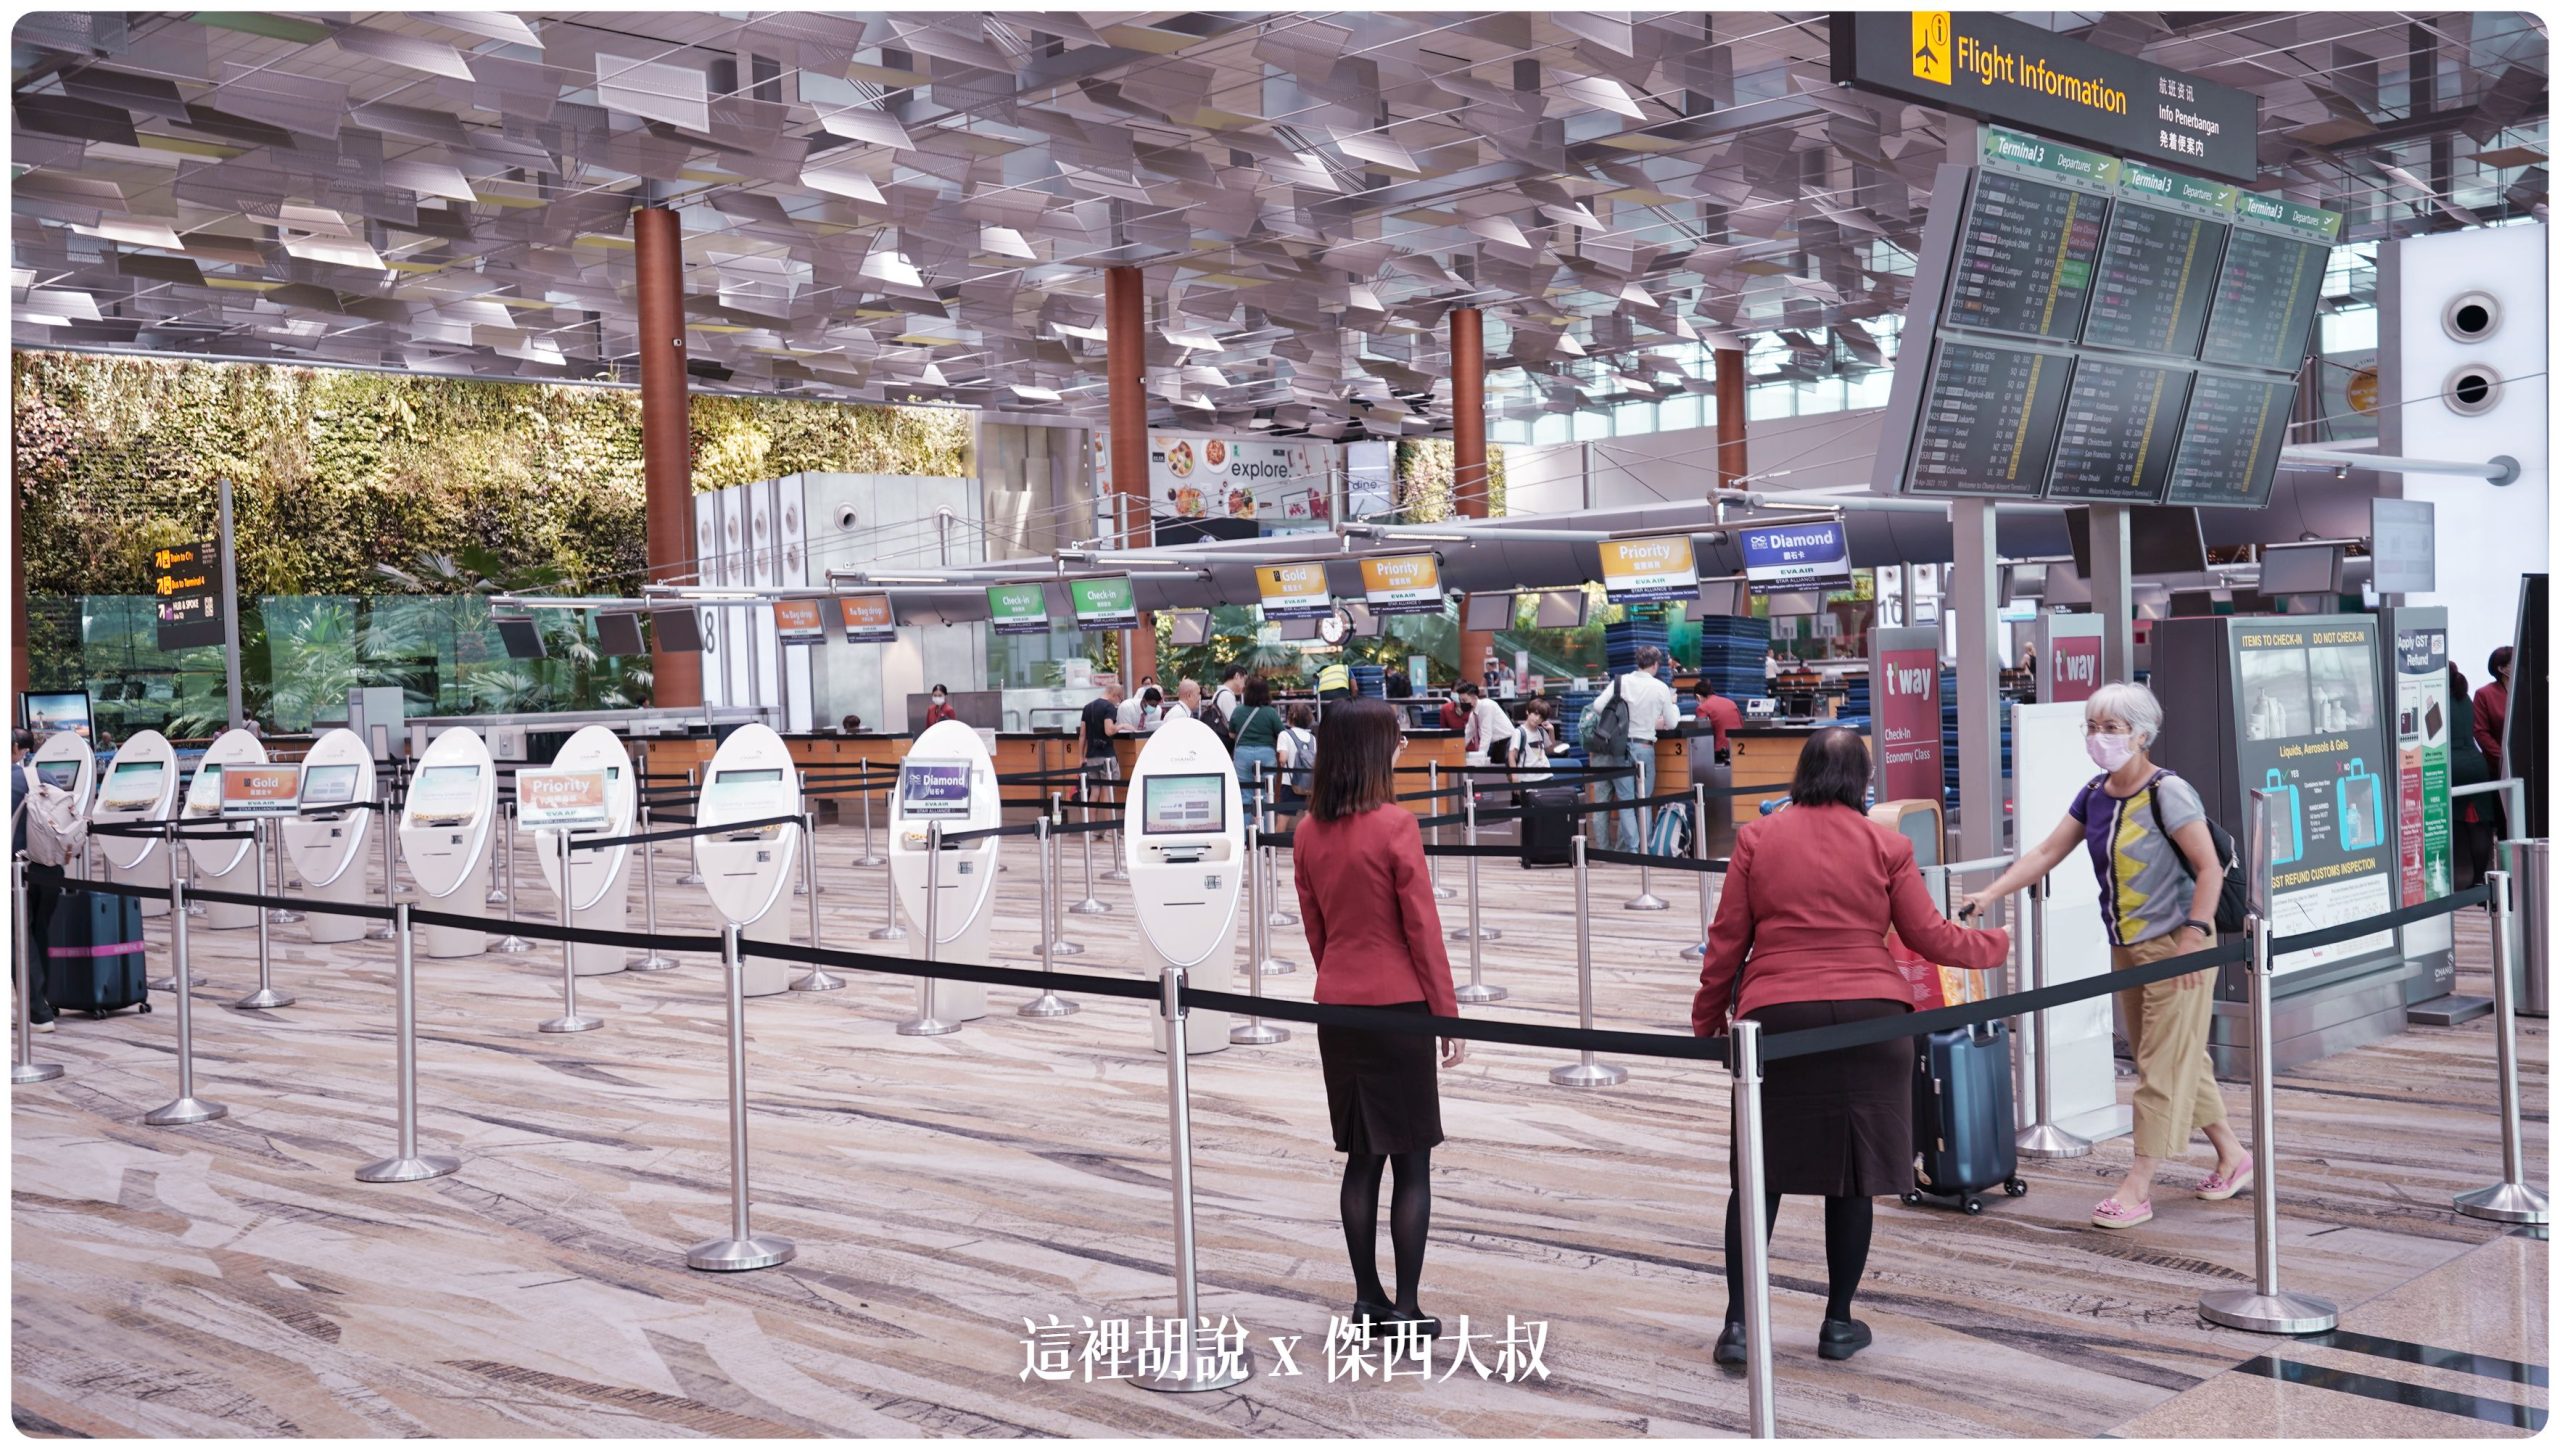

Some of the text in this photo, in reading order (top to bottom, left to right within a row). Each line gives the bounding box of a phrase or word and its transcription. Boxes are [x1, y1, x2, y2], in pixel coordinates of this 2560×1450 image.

[1958, 36, 2126, 114] Flight Information
[2159, 76, 2194, 102] 航班资讯
[2159, 104, 2219, 136] Info Penerbangan
[1999, 138, 2044, 162] Terminal 3
[2160, 130, 2204, 157] 発着便案内
[2058, 153, 2091, 172] Departures
[2132, 169, 2172, 192] Terminal 3
[2183, 184, 2213, 200] Departures
[2248, 199, 2283, 218] Terminal 3
[2293, 211, 2319, 225] Departures
[1231, 460, 1292, 480] explore.
[1770, 530, 1833, 549] Diamond
[1620, 544, 1670, 560] Priority
[1281, 569, 1306, 582] Gold
[1377, 561, 1418, 577] Priority
[1003, 596, 1029, 605] Check-in
[1087, 590, 1116, 600] Check-in
[705, 611, 715, 654] 8
[2242, 633, 2303, 647] ITEMS TO CHECK-IN
[2313, 631, 2365, 644] DO NOT CHECK-IN
[2398, 634, 2428, 651] Apply GST
[2407, 653, 2428, 666] Refund
[1030, 743, 1035, 754] 7
[1675, 742, 1682, 756] 3
[1737, 742, 1745, 755] 2
[1885, 748, 1930, 764] Economy Class
[2280, 739, 2349, 758] Liquids, Aerosols & Gels
[252, 777, 278, 788] Gold
[923, 774, 965, 786] Diamond
[2291, 770, 2299, 779] YES
[532, 778, 590, 794] Priority
[2272, 858, 2376, 889] GST REFUND CUSTOMS INSPECTION
